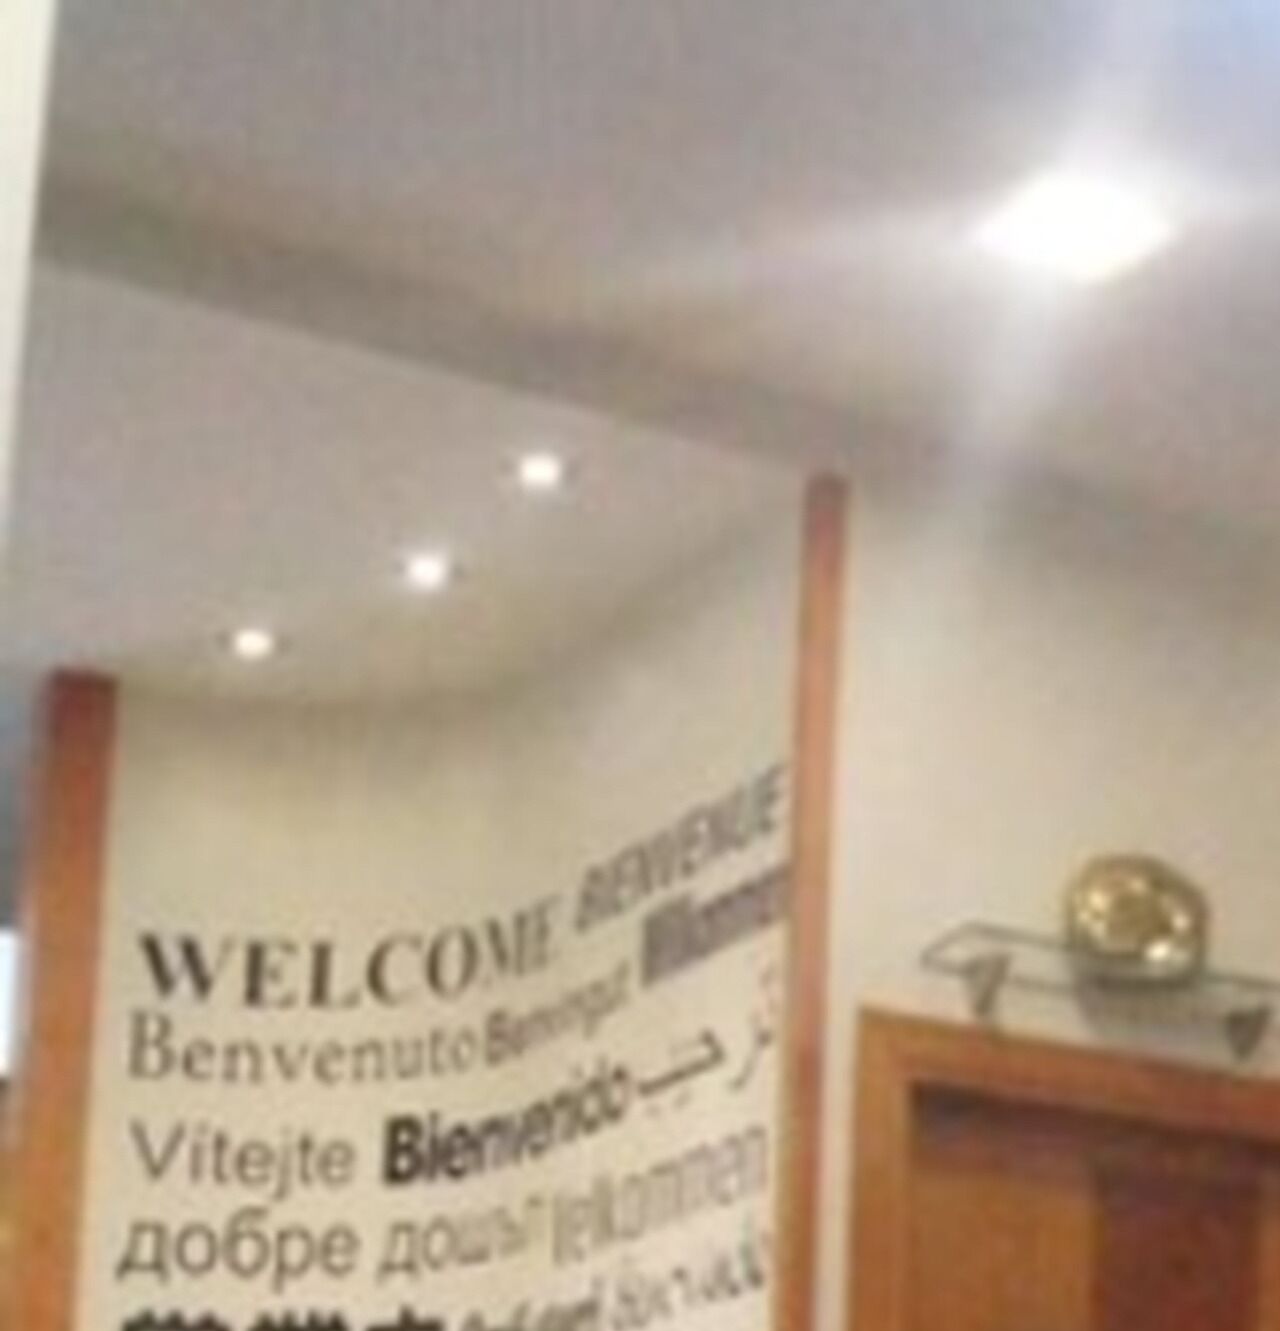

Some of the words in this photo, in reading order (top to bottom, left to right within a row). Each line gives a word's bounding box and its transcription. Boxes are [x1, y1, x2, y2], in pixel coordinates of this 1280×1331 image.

[138, 892, 562, 1010] WELCOME
[126, 1008, 484, 1082] Benvenuto
[382, 1066, 634, 1188] Bienvenido
[114, 1206, 362, 1298] добре
